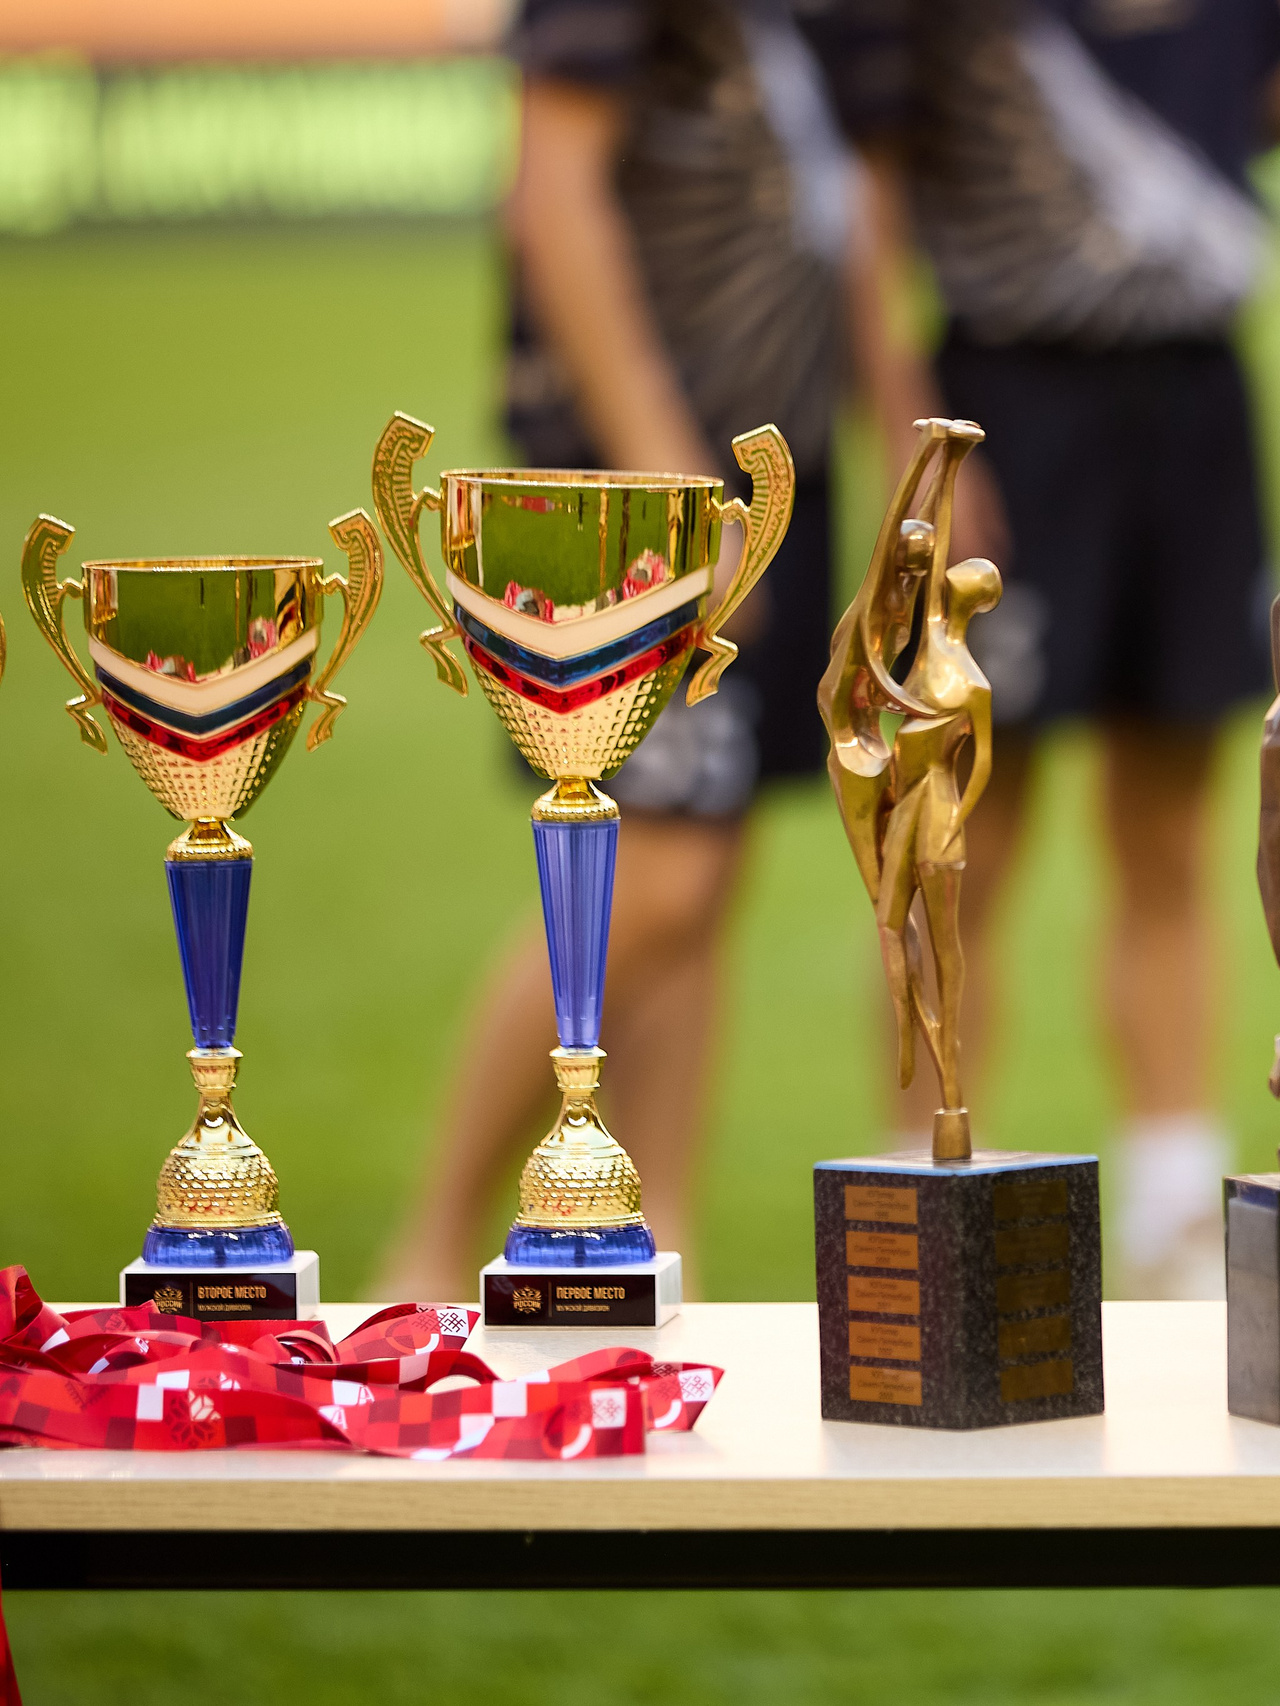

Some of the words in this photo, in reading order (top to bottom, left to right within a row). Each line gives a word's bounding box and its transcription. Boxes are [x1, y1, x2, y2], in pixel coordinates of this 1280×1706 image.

[197, 1285, 233, 1299] ВТОРОЕ
[234, 1285, 267, 1299] МЕСТО
[556, 1286, 592, 1300] ПЕРВОЕ
[593, 1286, 626, 1300] МЕСТО
